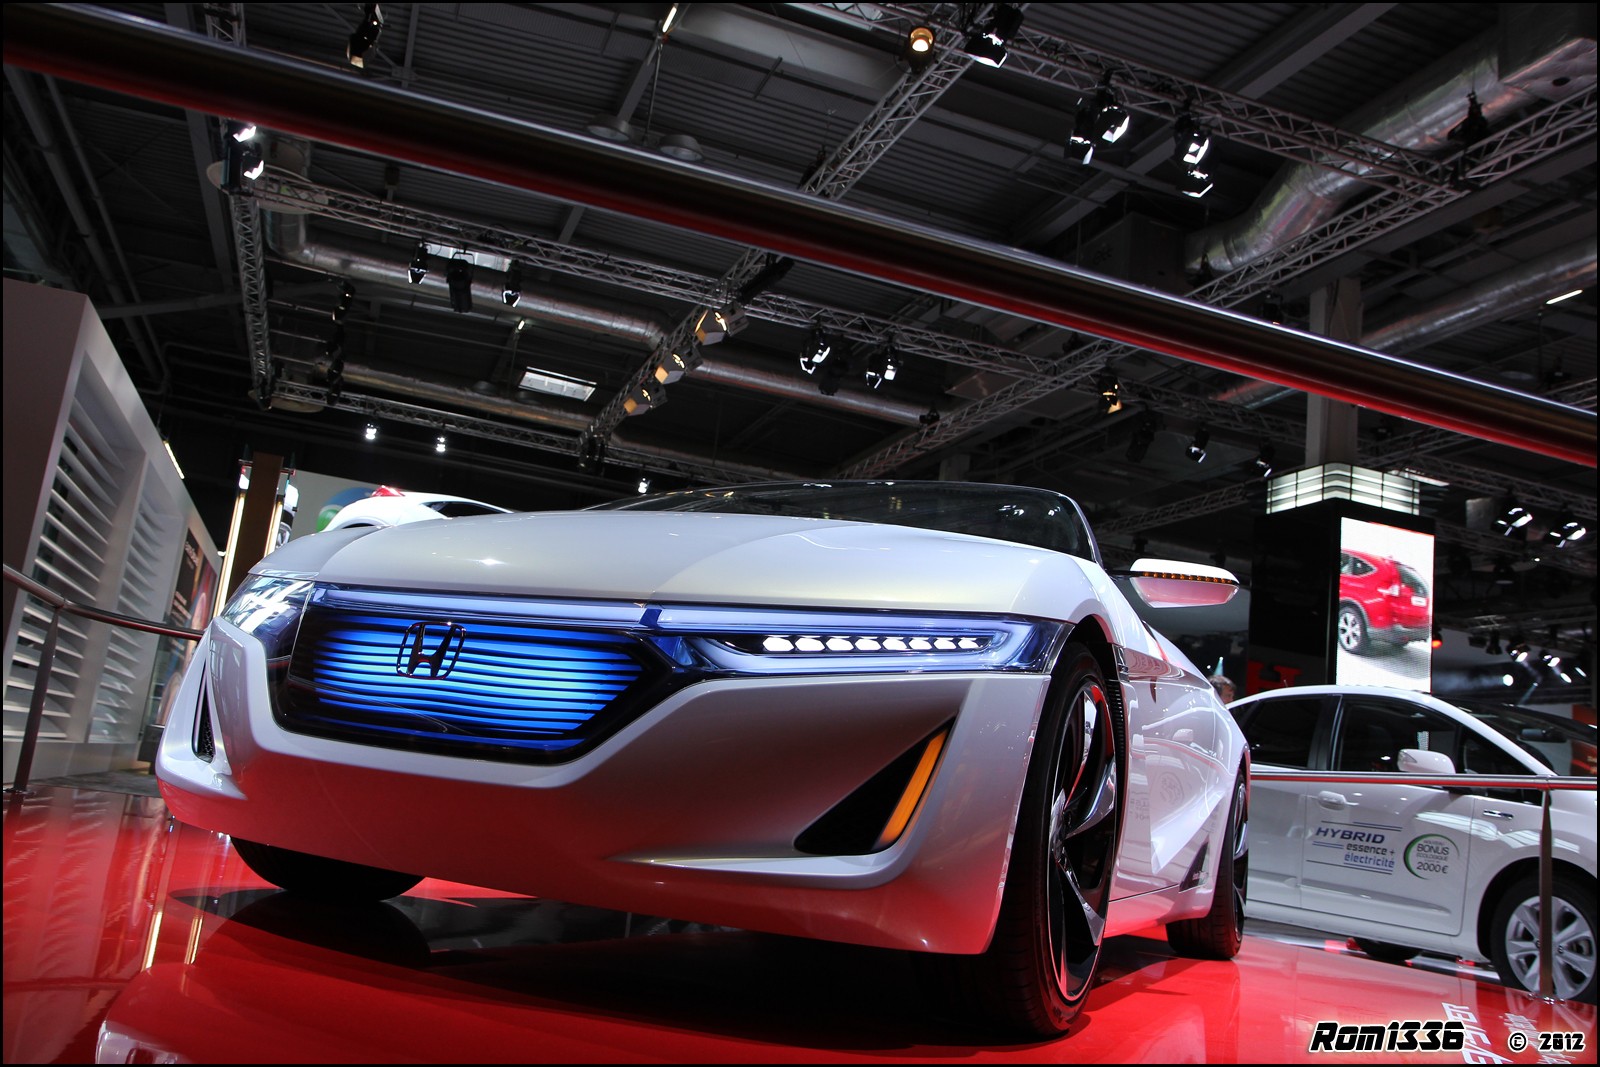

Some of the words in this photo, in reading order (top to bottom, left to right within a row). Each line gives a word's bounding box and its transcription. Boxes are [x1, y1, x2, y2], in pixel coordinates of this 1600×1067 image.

[1315, 827, 1385, 844] HYBRID
[1346, 842, 1388, 856] essence
[1416, 843, 1450, 856] BONUS
[1344, 852, 1395, 868] électricité
